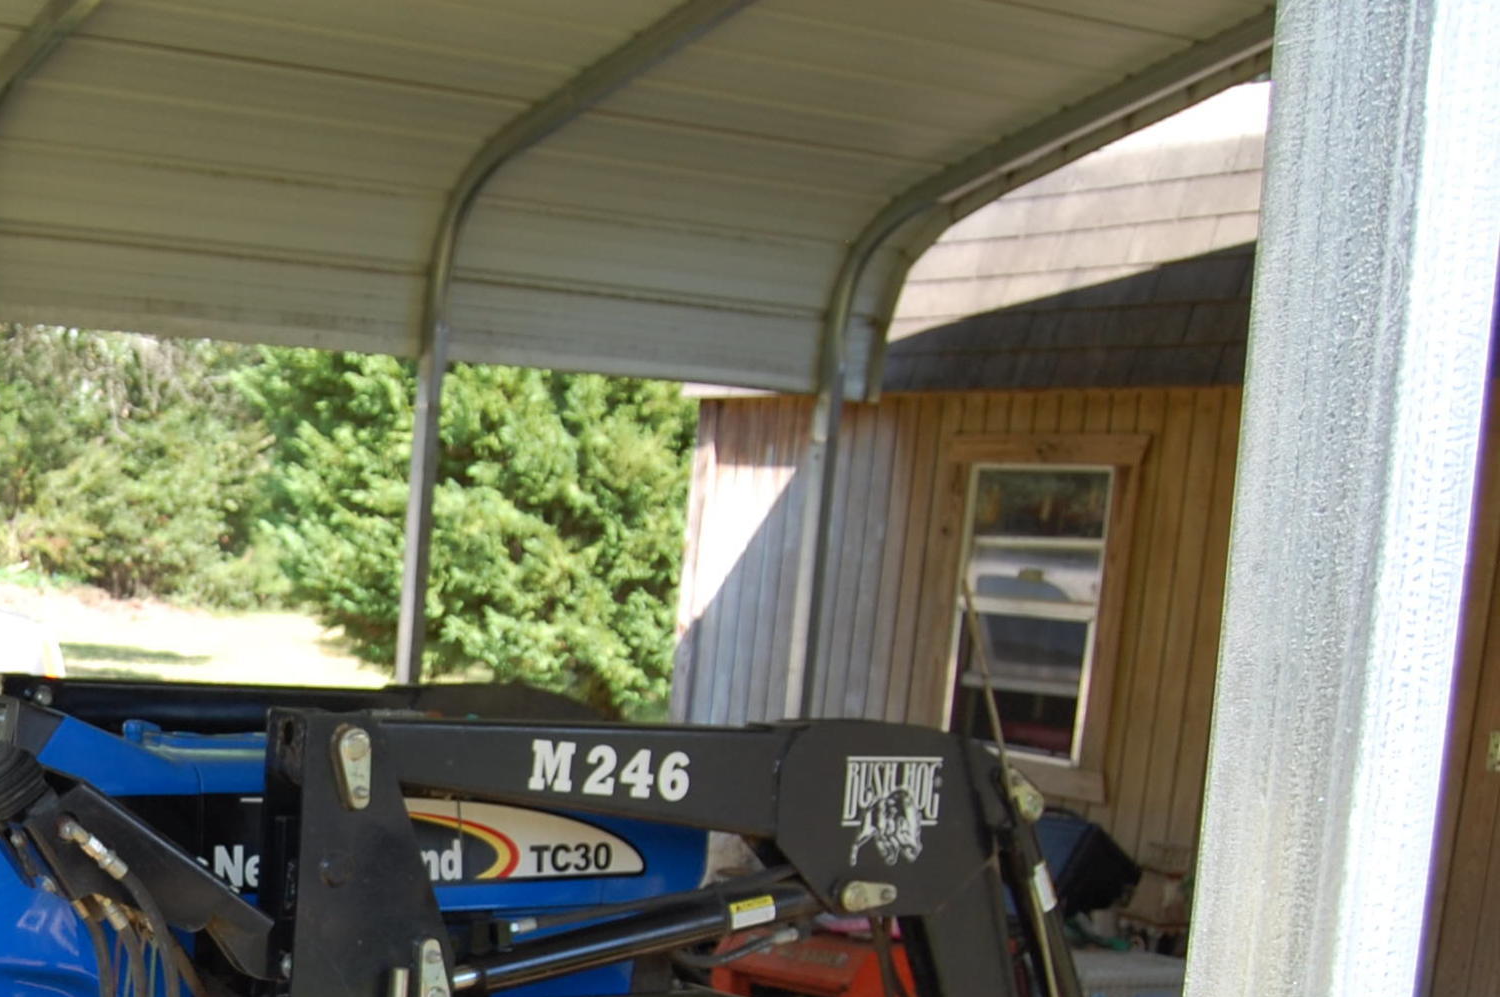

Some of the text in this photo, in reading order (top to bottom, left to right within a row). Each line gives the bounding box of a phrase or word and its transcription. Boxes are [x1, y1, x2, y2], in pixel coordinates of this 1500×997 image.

[843, 761, 899, 820] BUSH
[213, 844, 260, 888] Ne
[529, 842, 612, 873] TC30
